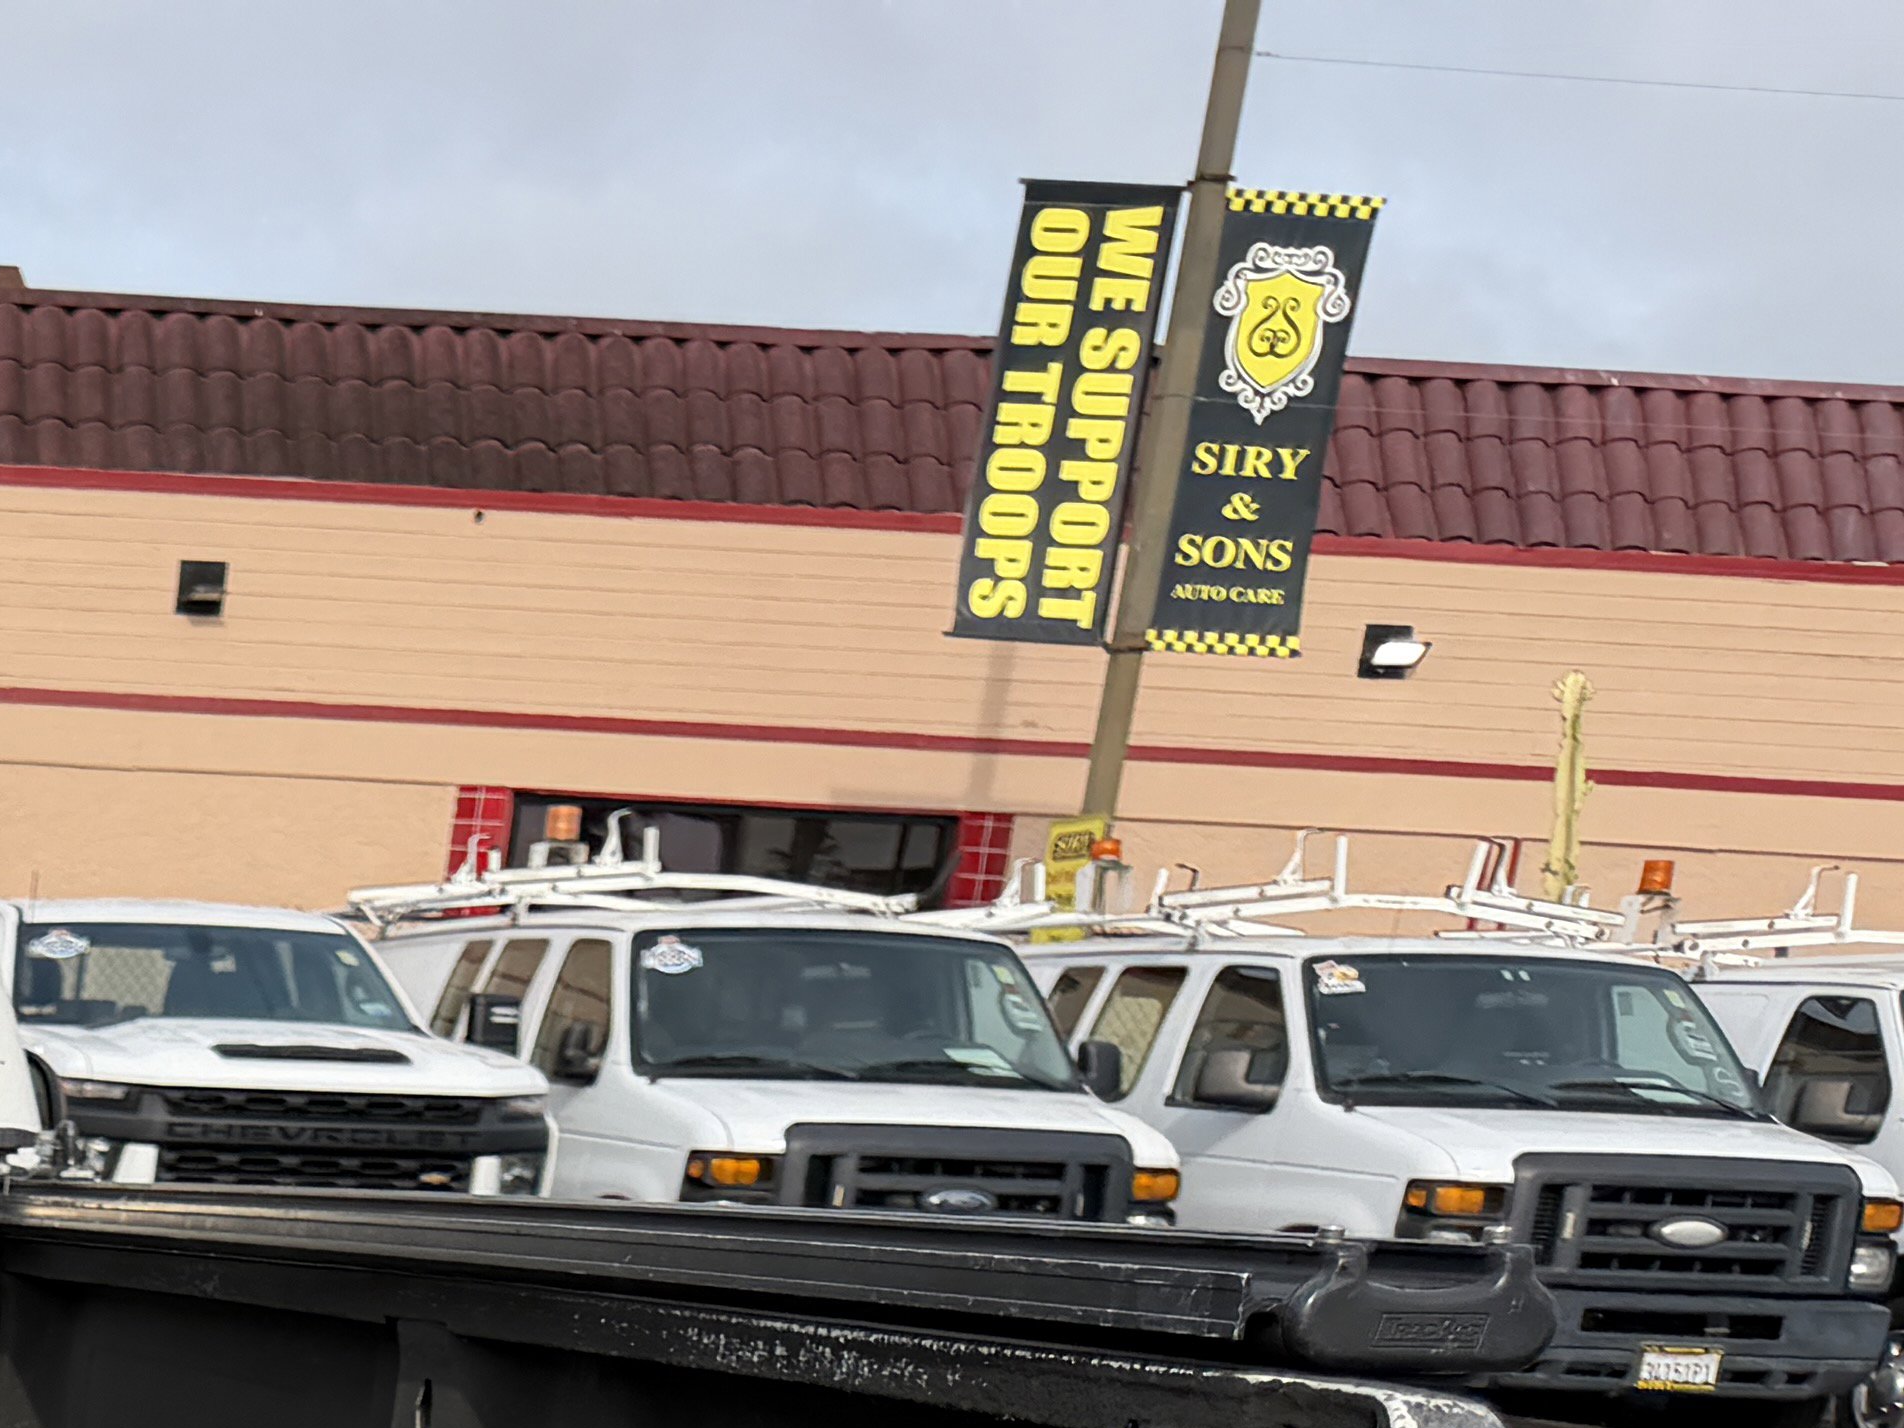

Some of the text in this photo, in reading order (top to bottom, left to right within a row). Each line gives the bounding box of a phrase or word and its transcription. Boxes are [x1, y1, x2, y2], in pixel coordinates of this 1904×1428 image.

[968, 207, 1091, 620] OUR TROOPS
[1037, 205, 1164, 629] WE SUPPORT
[1192, 442, 1311, 481] SIRY
[1222, 493, 1261, 521] &
[1175, 534, 1294, 572] SONS
[1171, 583, 1286, 605] AUTO CARE
[166, 1121, 475, 1149] CHEVROLET
